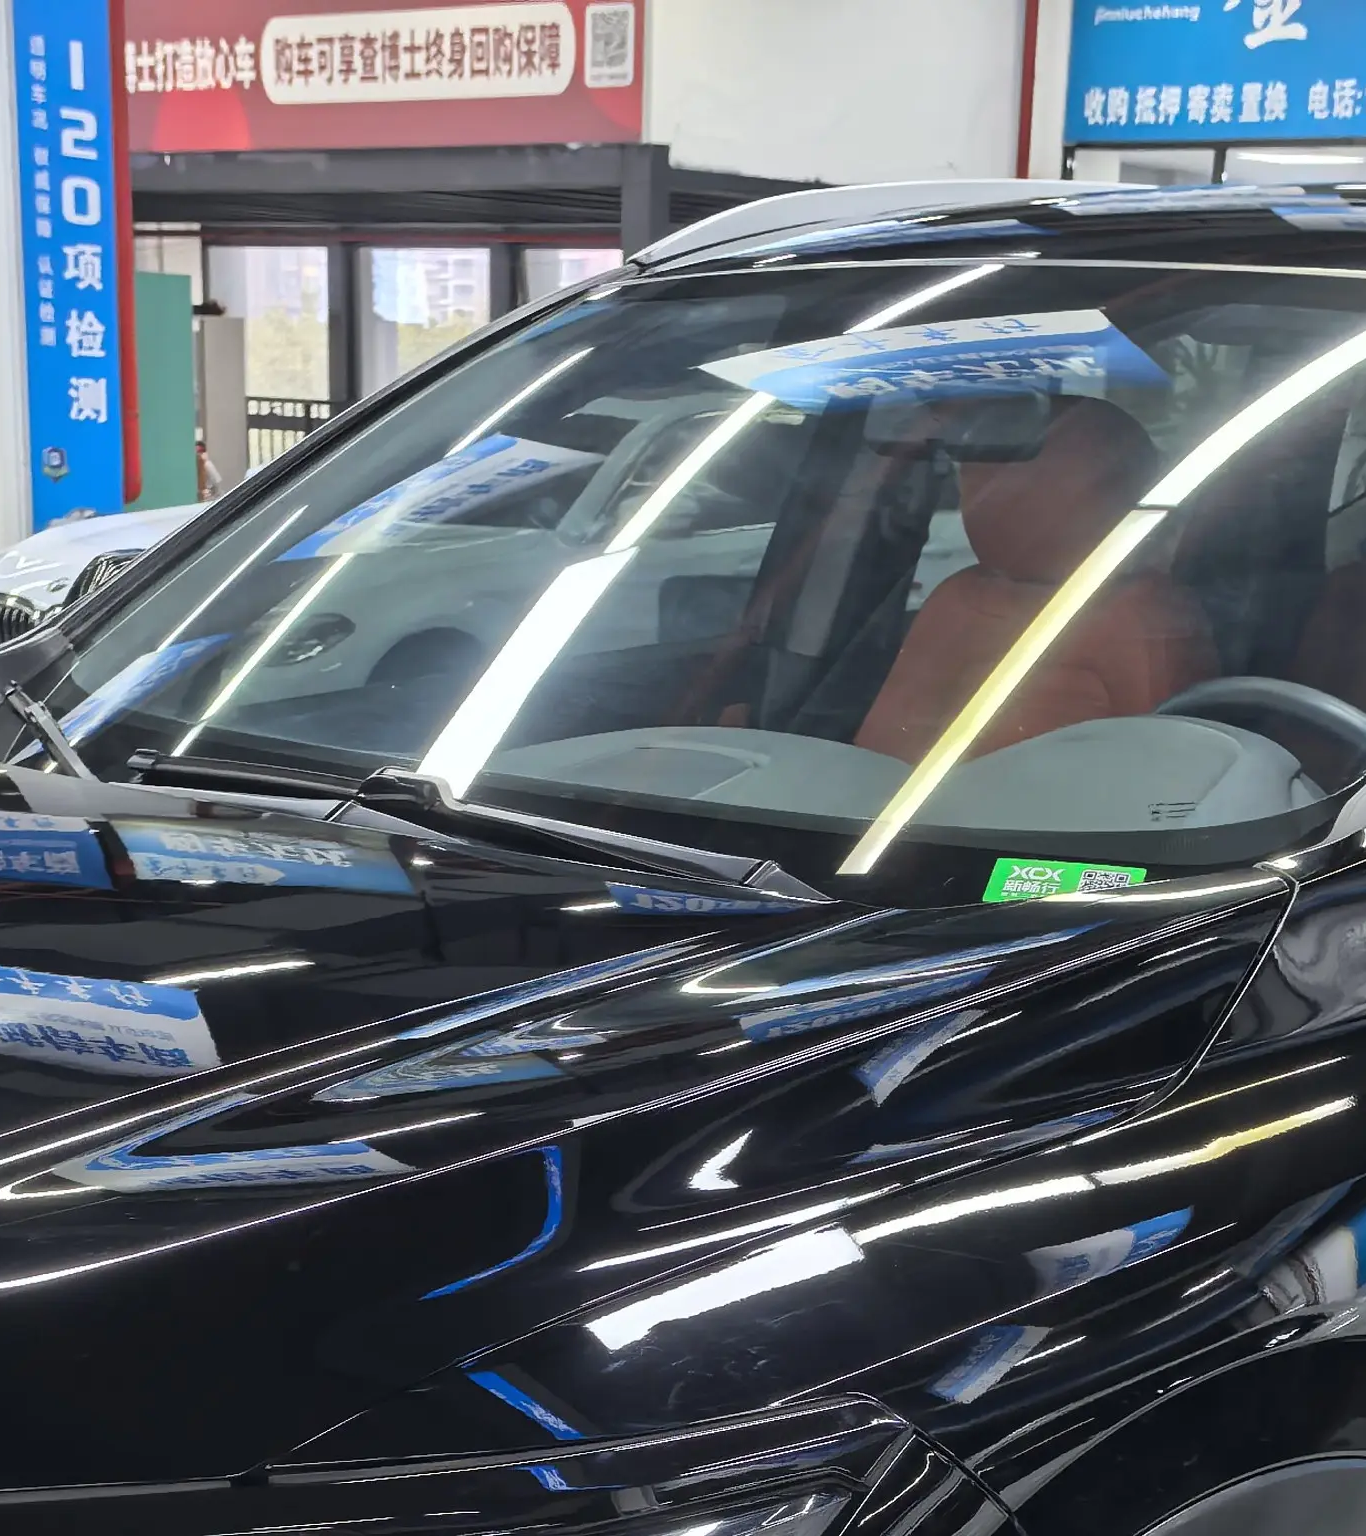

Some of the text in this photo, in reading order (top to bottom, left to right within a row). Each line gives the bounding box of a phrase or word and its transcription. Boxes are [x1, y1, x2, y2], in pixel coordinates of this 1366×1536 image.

[272, 22, 562, 86] 购车可享查博士终身回购保障
[1084, 86, 1128, 126] 收购
[1187, 81, 1235, 124] 寄卖
[1238, 80, 1288, 123] 置换
[59, 40, 109, 424] 120项检测
[1003, 880, 1061, 894] 新畅行
